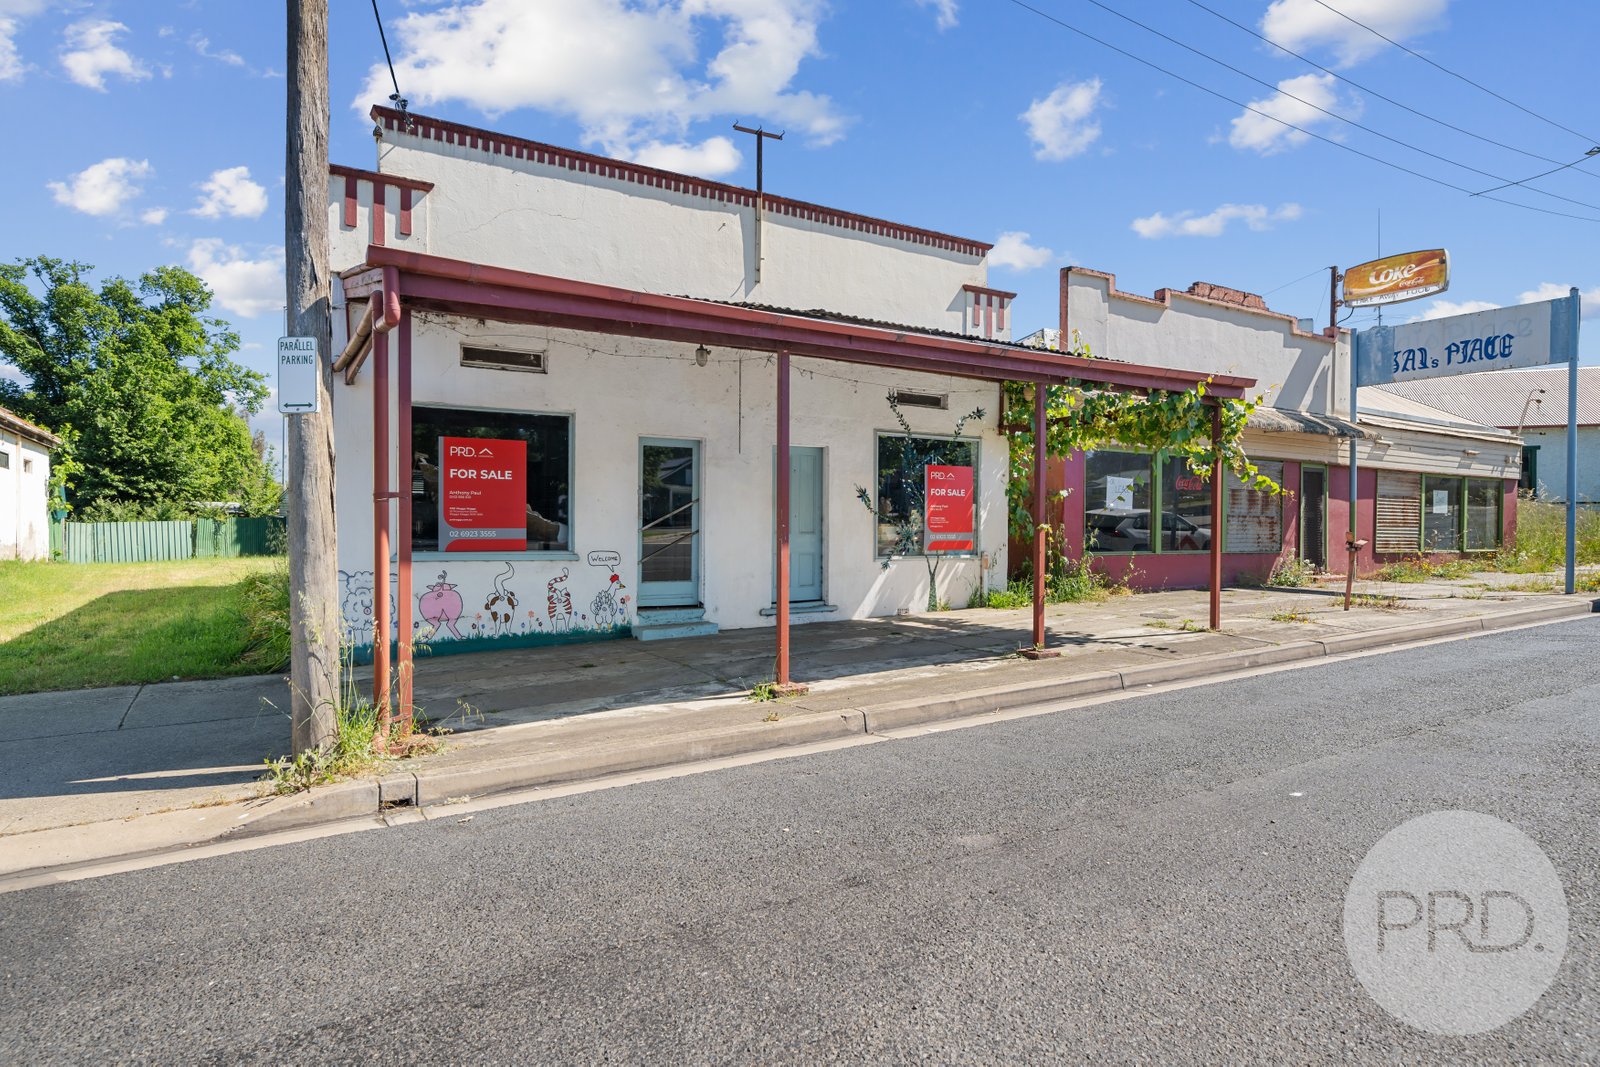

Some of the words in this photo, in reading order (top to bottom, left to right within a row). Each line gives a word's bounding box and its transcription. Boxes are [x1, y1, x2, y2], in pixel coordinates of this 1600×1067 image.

[1406, 286, 1431, 295] FOOD
[280, 341, 314, 351] PARALLEL
[281, 355, 314, 365] PARKING
[450, 469, 477, 479] FOR
[480, 470, 513, 480] SALE
[930, 488, 946, 496] FOR
[947, 489, 966, 497] SALE
[590, 554, 618, 562] WELCOME
